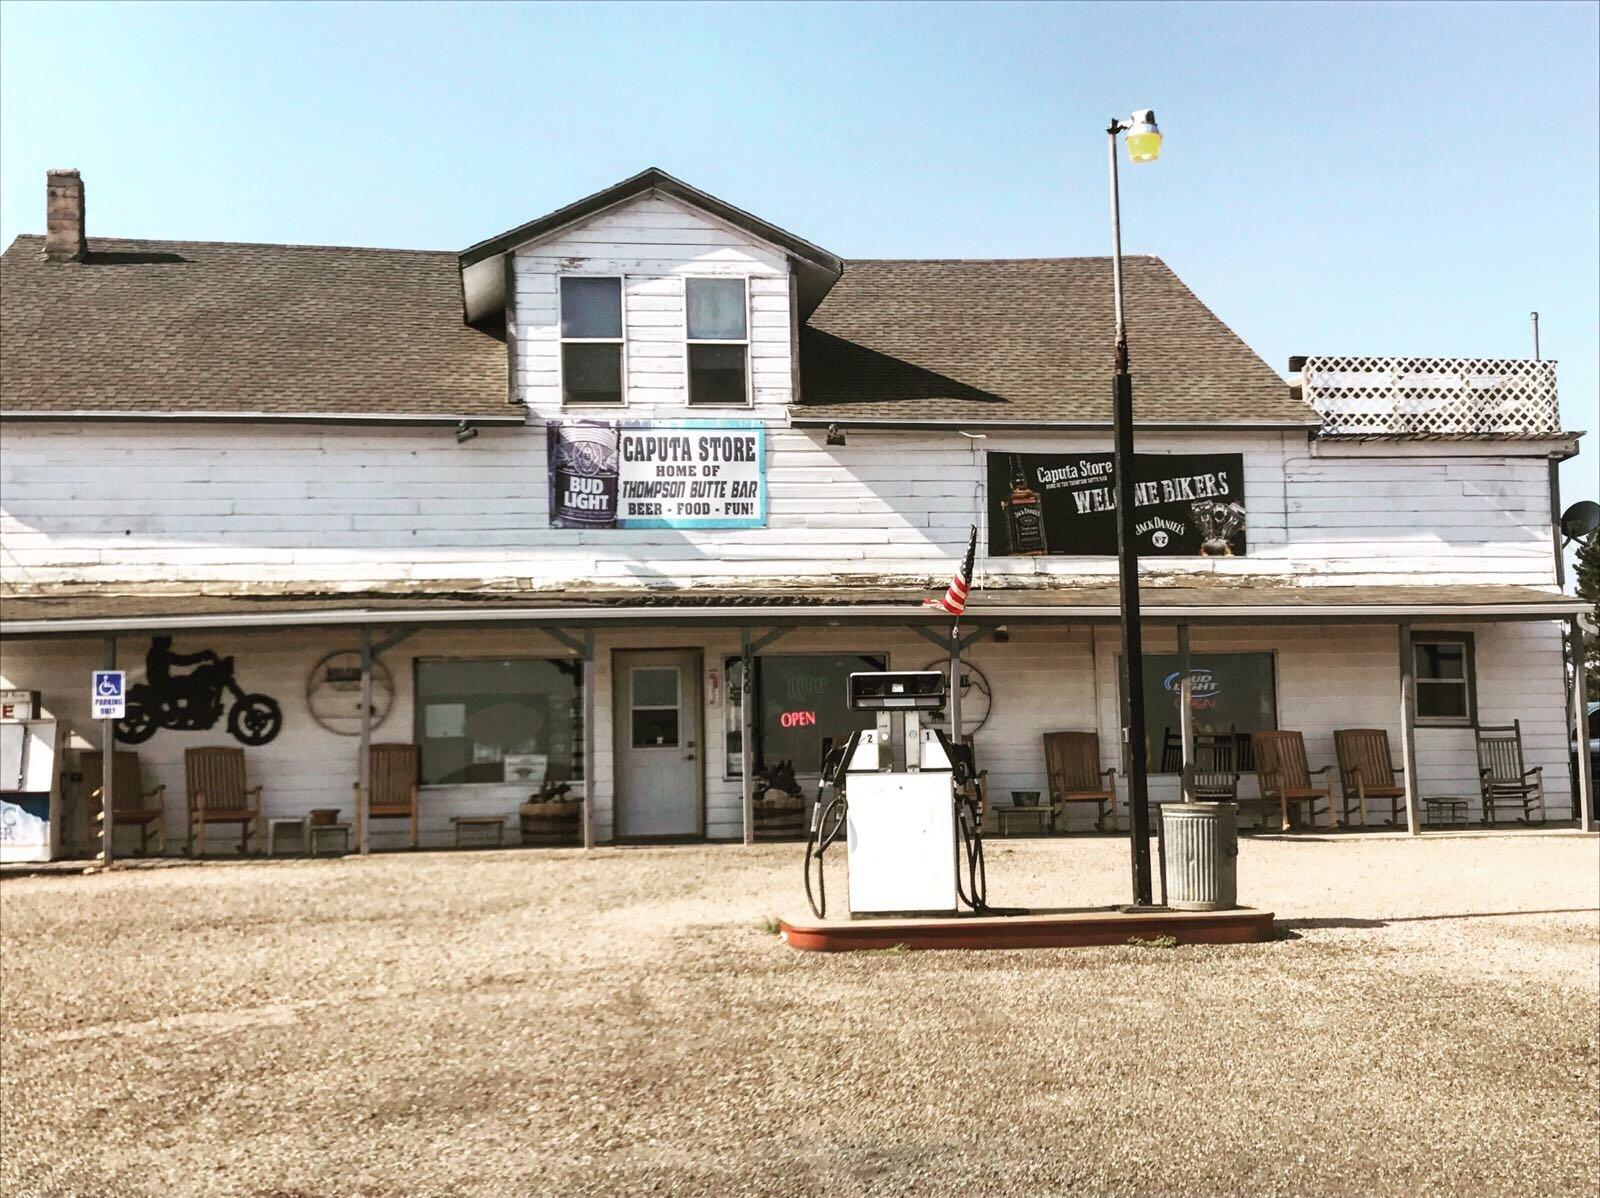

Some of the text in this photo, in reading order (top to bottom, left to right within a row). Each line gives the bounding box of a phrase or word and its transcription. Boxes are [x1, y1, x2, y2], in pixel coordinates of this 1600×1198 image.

[622, 436, 692, 462] CAPUTA
[698, 436, 756, 462] STORE
[655, 465, 720, 477] HOME OF
[1036, 460, 1113, 484] Caputa Store
[569, 476, 604, 495] BUD
[622, 480, 758, 498] THOMPSON BUTTE BAR
[1071, 471, 1230, 514] WELME BIKERS
[563, 491, 610, 510] LIGHT
[627, 502, 663, 516] BEER
[676, 502, 711, 516] FOOD
[724, 502, 754, 516] FUN!
[1190, 674, 1213, 683] UD
[95, 698, 123, 706] PARKING
[780, 711, 816, 728] OPEN
[866, 731, 931, 743] 2 1
